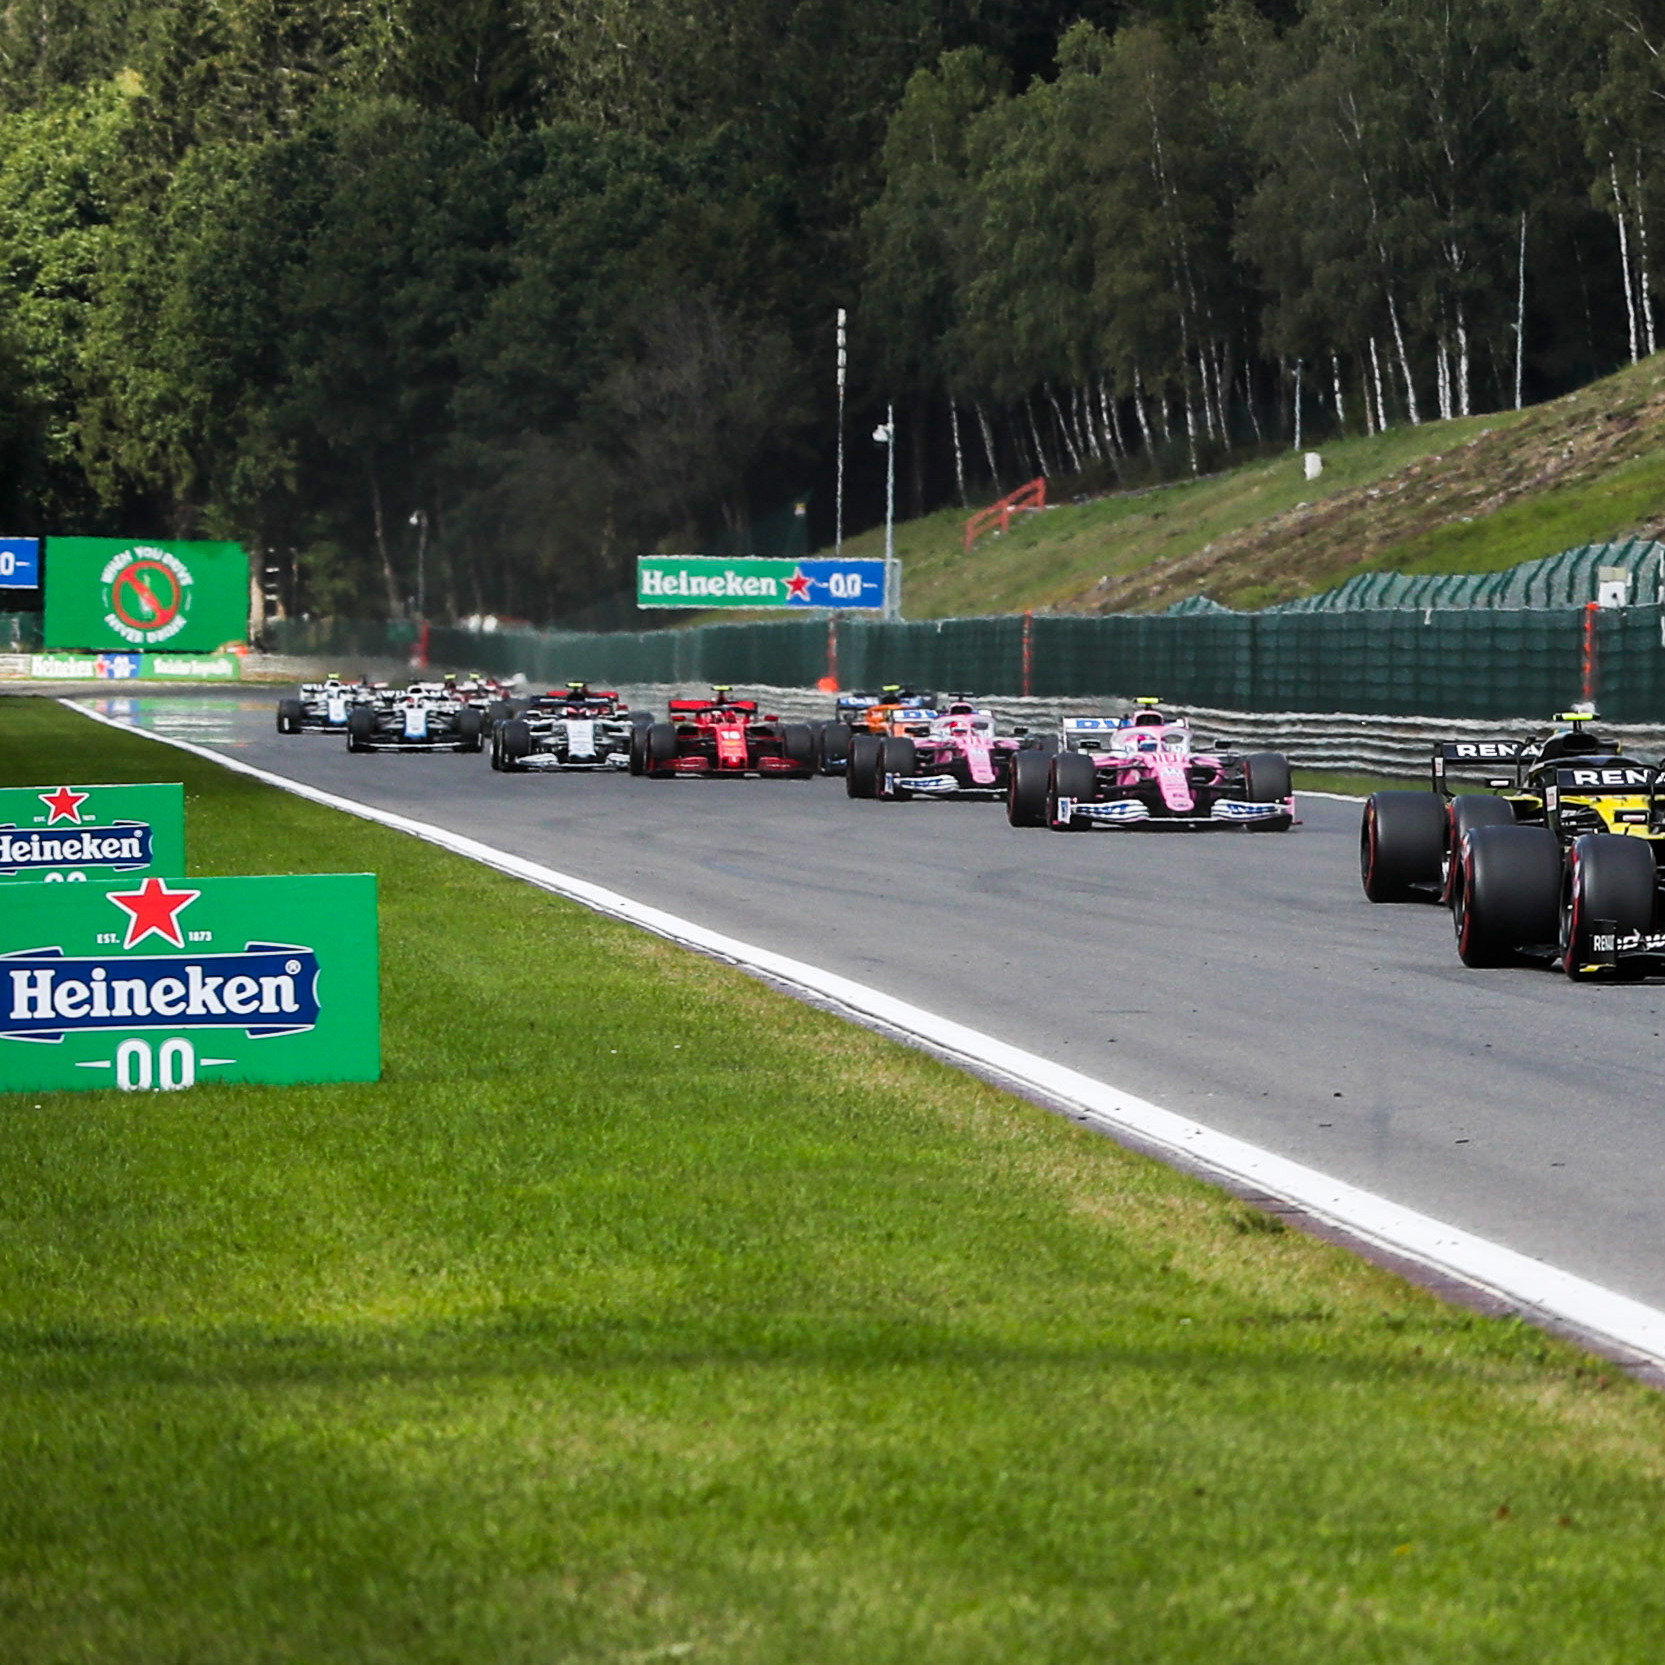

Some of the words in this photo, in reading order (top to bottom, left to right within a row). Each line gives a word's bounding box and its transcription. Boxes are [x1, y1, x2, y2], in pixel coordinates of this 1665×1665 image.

[640, 570, 777, 597] Heineken
[97, 933, 120, 945] EST.
[188, 931, 212, 942] 1873
[9, 965, 300, 1019] Heineken
